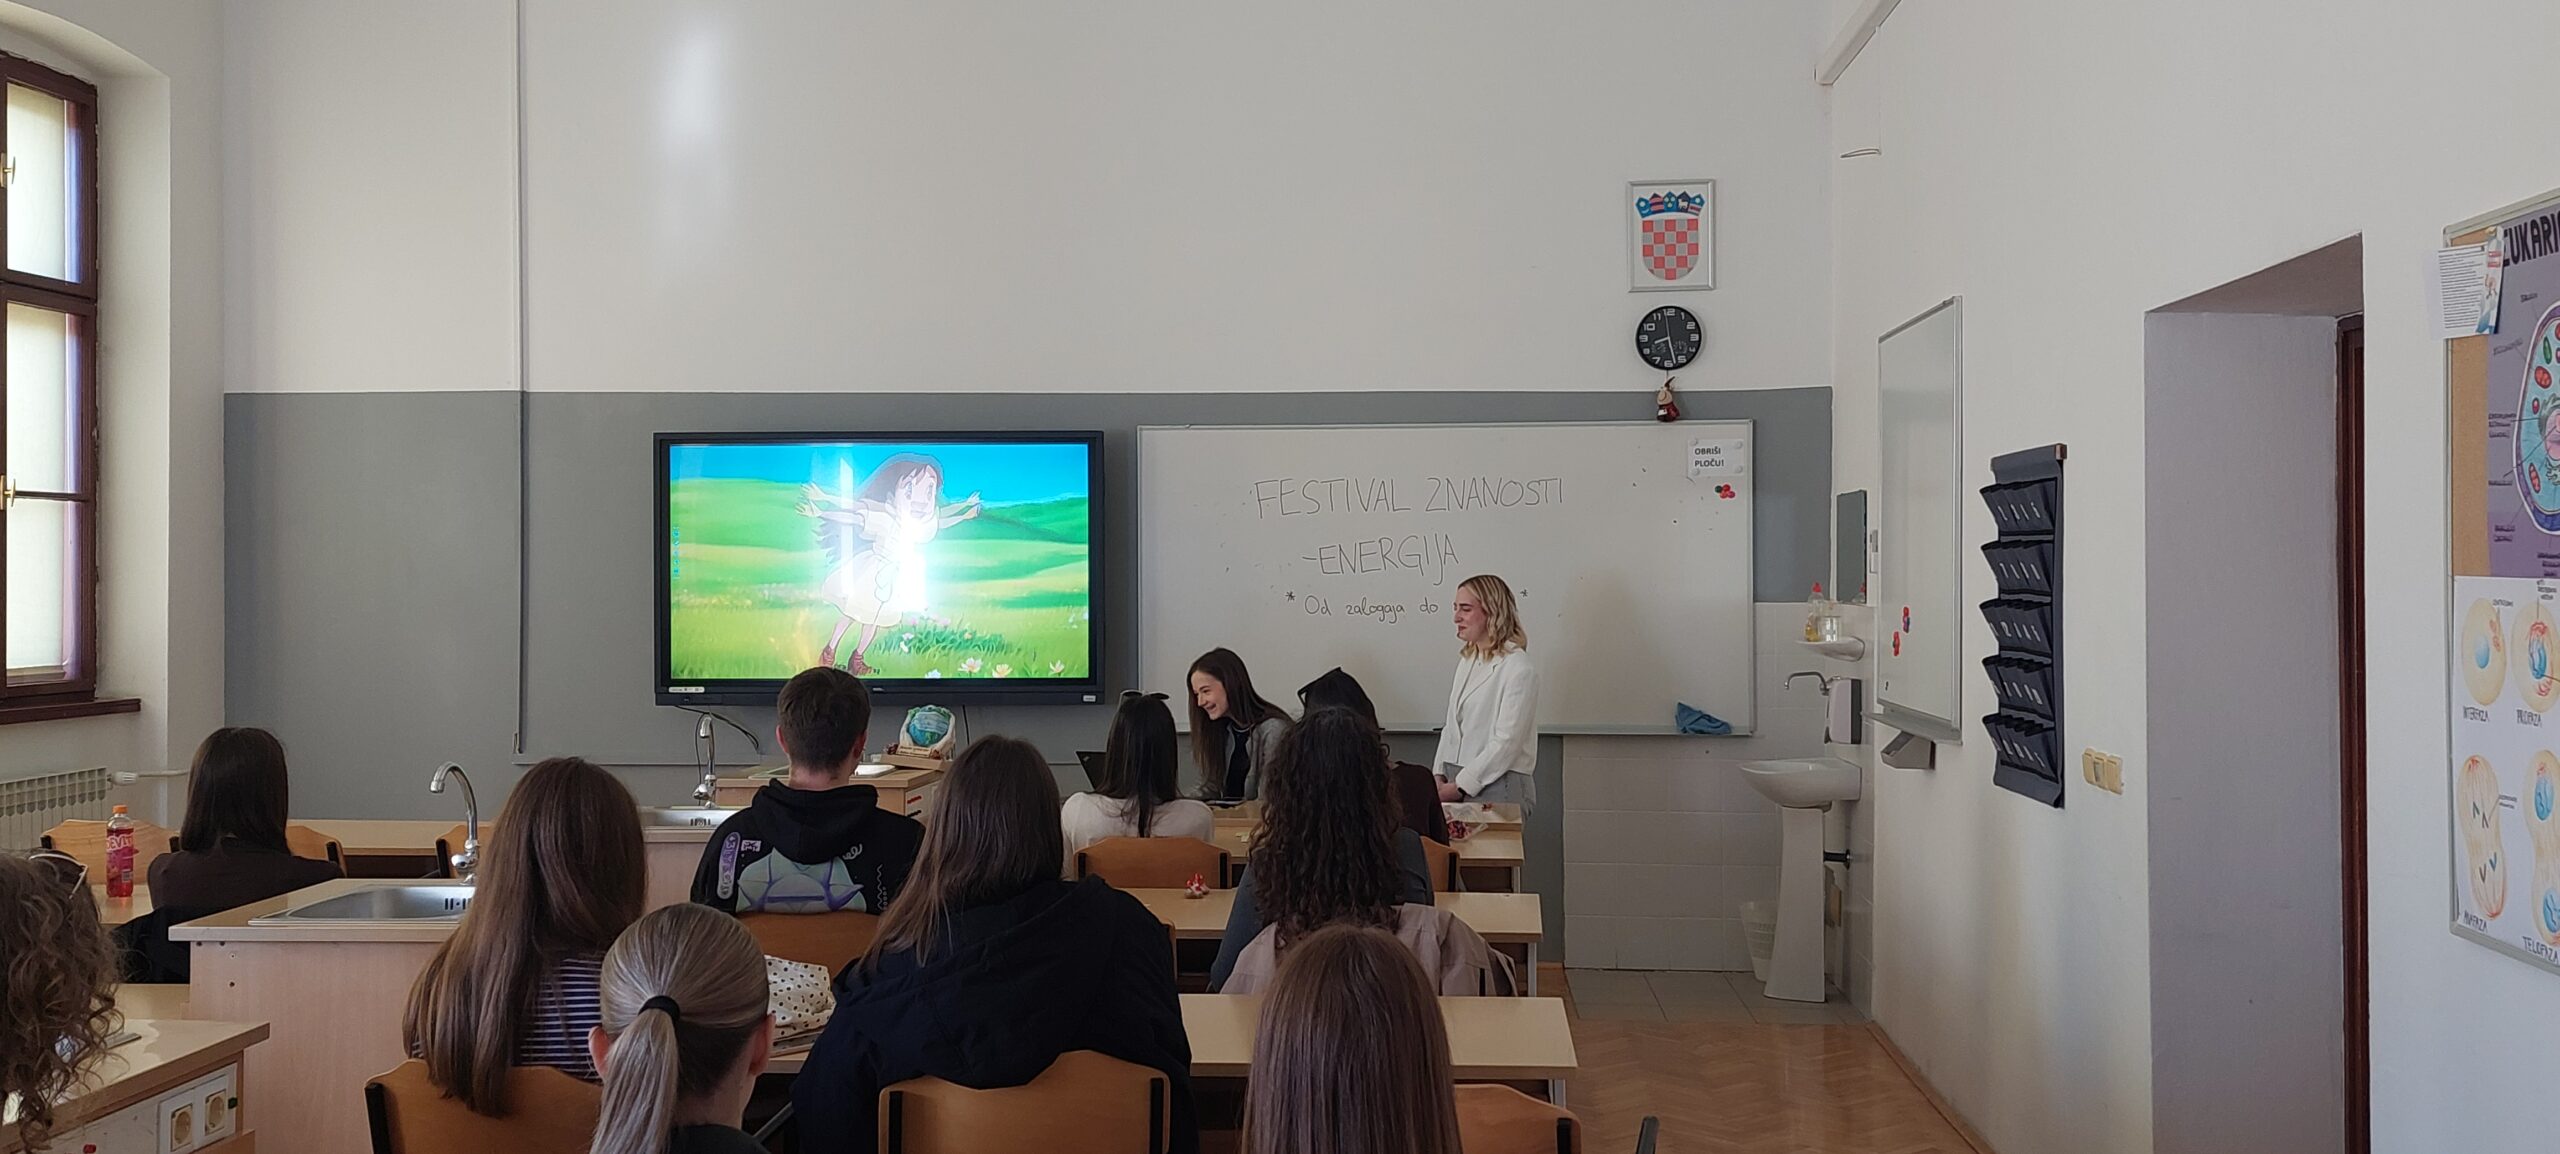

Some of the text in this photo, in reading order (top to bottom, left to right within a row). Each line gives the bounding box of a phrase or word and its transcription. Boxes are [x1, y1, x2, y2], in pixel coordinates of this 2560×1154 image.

[2503, 211, 2560, 268] EUKARI
[1653, 312, 1661, 321] 11
[1663, 308, 1676, 316] 12
[1680, 311, 1685, 321] 1
[1643, 322, 1656, 331] 10
[1686, 321, 1696, 330] 2
[1639, 334, 1648, 343] 9
[1690, 333, 1699, 342] 3
[1652, 356, 1661, 365] 7
[1663, 360, 1674, 368] 6
[1677, 355, 1687, 364] 5
[1694, 446, 1721, 456] OBRIŠI
[1694, 458, 1725, 468] PLOČU!
[1254, 476, 1563, 519] FESTIVAL ZNANOSTI
[1303, 595, 1439, 625] Od zalogaja do
